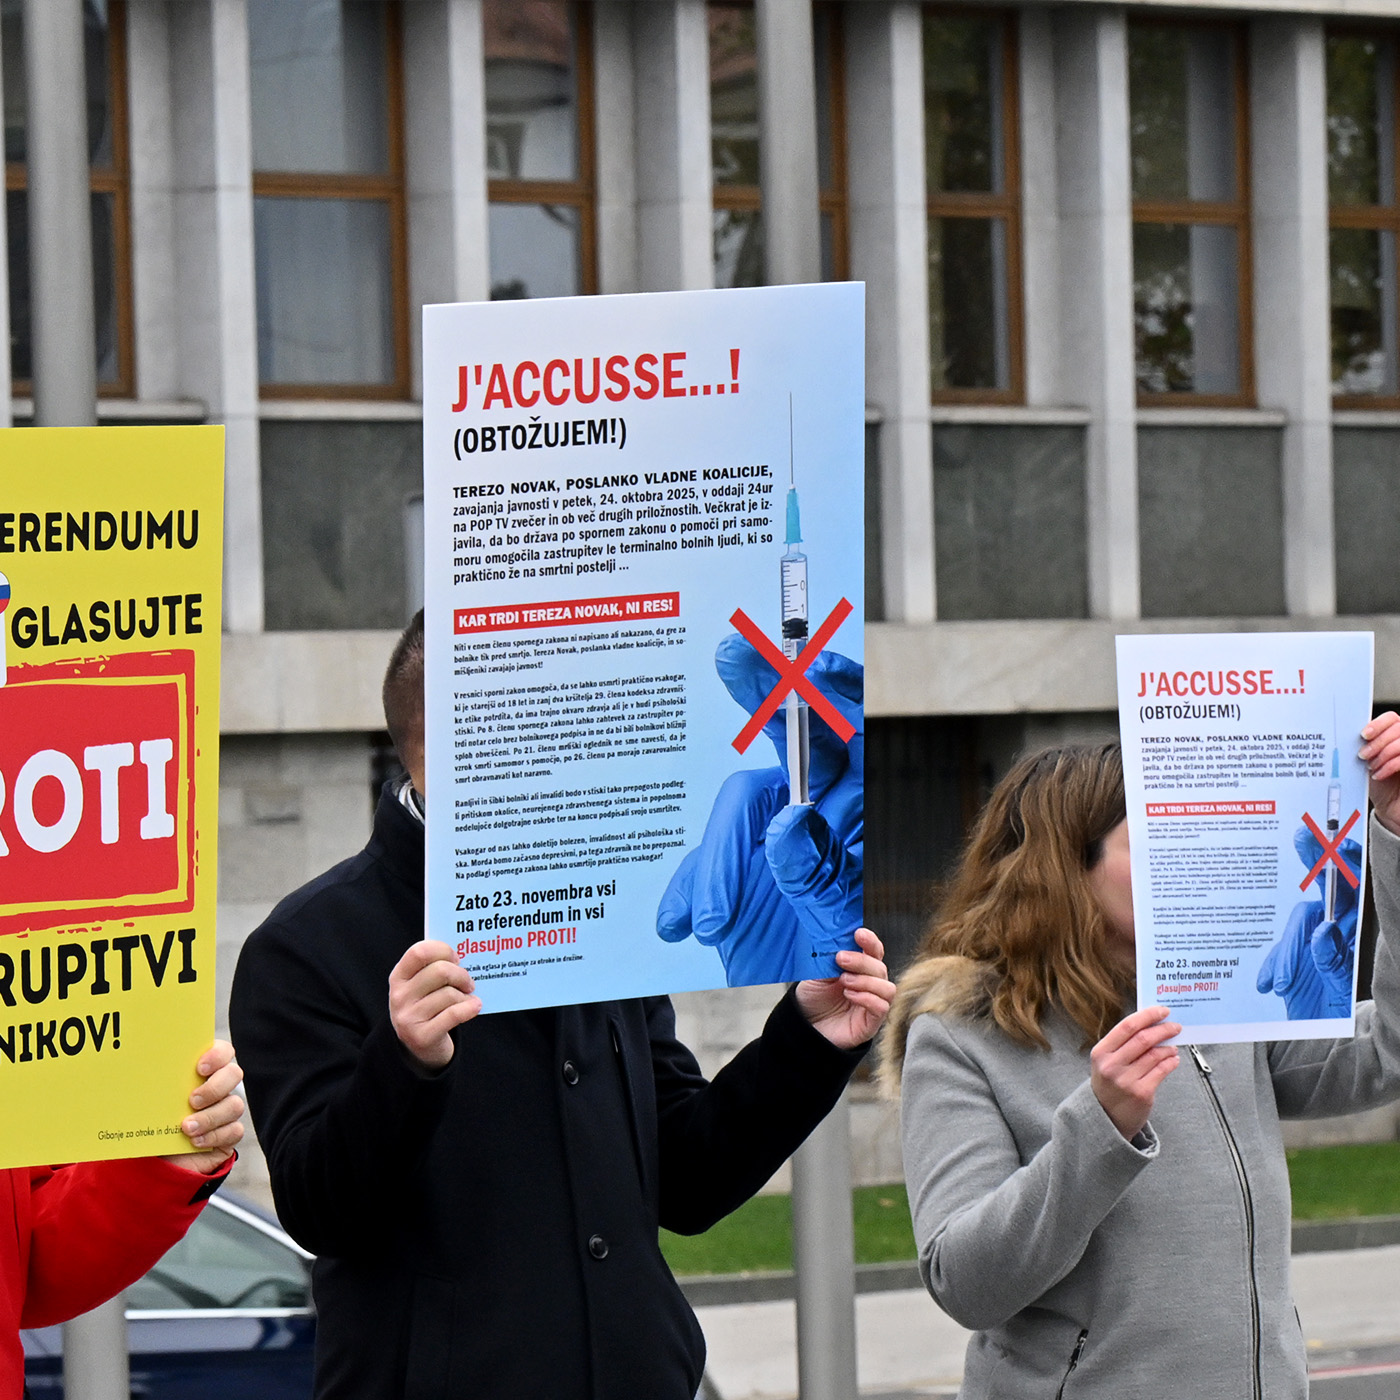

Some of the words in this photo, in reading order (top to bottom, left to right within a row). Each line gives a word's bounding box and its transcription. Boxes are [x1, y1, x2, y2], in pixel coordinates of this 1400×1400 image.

[452, 348, 741, 412] J'ACCUSSE...!
[453, 415, 627, 460] (OBTOŽUJEM!)
[453, 484, 505, 499] TEREZO
[511, 480, 560, 494] NOVAK,
[566, 474, 639, 490] POSLANKO
[644, 470, 697, 485] VLADNE
[703, 465, 773, 481] KOALICIJE,
[453, 501, 504, 517] zavajanja
[507, 497, 550, 515] javnosti
[553, 500, 559, 509] v
[562, 495, 596, 510] petek,
[600, 493, 618, 506] 24.
[621, 490, 663, 504] oktobra
[667, 487, 699, 500] 2025,
[702, 489, 708, 498] v
[711, 483, 744, 498] oddaji
[748, 482, 774, 495] 24ur
[453, 523, 467, 533] na
[470, 518, 493, 532] POP
[495, 517, 509, 530] TV
[511, 515, 546, 528] zvečer
[549, 513, 559, 526] in
[561, 513, 575, 525] ob
[577, 510, 596, 523] več
[599, 508, 633, 523] drugih
[636, 503, 702, 522] priložnostih.
[704, 500, 746, 514] Večkrat
[748, 498, 758, 514] je
[761, 498, 773, 510] iz-
[453, 536, 486, 552] javila,
[489, 535, 503, 547] da
[506, 534, 520, 545] bo
[523, 531, 558, 544] država
[562, 531, 576, 544] po
[579, 528, 625, 542] spornem
[628, 524, 667, 536] zakonu
[670, 524, 677, 533] o
[680, 517, 719, 535] pomoči
[722, 516, 737, 532] pri
[740, 517, 773, 528] samo-
[454, 556, 481, 567] moru
[485, 549, 540, 565] omogočila
[544, 544, 604, 560] zastrupitev
[606, 544, 616, 555] le
[620, 539, 678, 554] terminalno
[681, 535, 714, 549] bolnih
[717, 533, 744, 549] ljudi,
[747, 531, 757, 544] ki
[760, 533, 773, 543] so
[454, 568, 506, 586] praktično
[508, 566, 520, 579] že
[523, 568, 536, 578] na
[539, 562, 574, 577] smrtni
[576, 558, 616, 576] postelji
[11, 593, 203, 649] GLASUJTE
[459, 613, 487, 628] KAR
[490, 611, 519, 625] TRDI
[521, 606, 572, 623] TEREZA
[575, 603, 623, 619] NOVAK,
[626, 601, 640, 614] NI
[643, 598, 673, 612] RES!
[1137, 669, 1305, 697] J'ACCUSSE...!
[1139, 701, 1241, 723] (OBTOŽUJEM!)
[1149, 805, 1165, 814] KAR
[1166, 805, 1184, 813] TRDI
[1185, 805, 1215, 813] TEREZA
[1216, 804, 1244, 812] NOVAK,
[456, 894, 489, 911] Zato
[493, 890, 517, 908] 23.
[521, 883, 592, 905] novembra
[597, 880, 616, 897] vsi
[456, 918, 474, 933] na
[478, 908, 564, 929] referendum
[568, 905, 579, 921] in
[585, 903, 605, 920] vsi
[456, 931, 523, 959] glasujmo
[527, 927, 577, 948] PROTI!
[1155, 958, 1175, 969] Zato
[1176, 958, 1190, 969] 23.
[1191, 958, 1229, 968] novembra
[1229, 956, 1239, 967] vsi
[1156, 971, 1166, 981] na
[1168, 969, 1213, 980] referendum
[1214, 969, 1222, 979] in
[1223, 968, 1233, 978] vsi
[1156, 982, 1192, 995] glasujmo
[1194, 981, 1219, 992] PROTI!
[98, 1131, 123, 1141] Gibanje
[135, 1126, 155, 1137] otroke
[165, 1125, 182, 1135] druži
